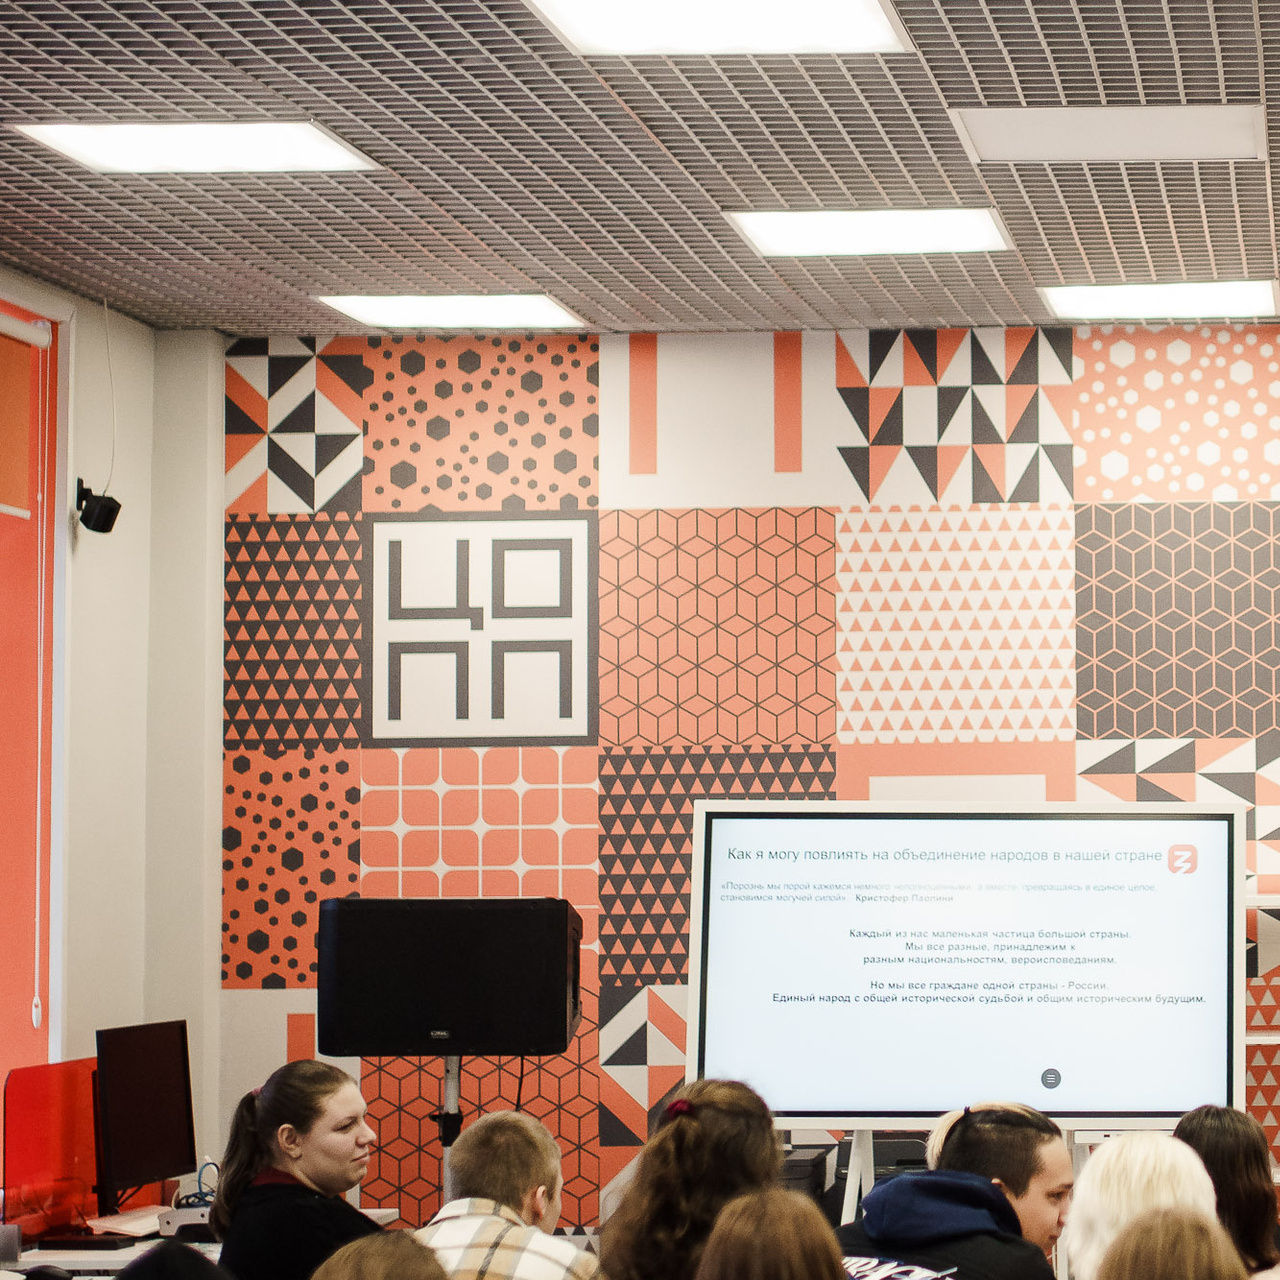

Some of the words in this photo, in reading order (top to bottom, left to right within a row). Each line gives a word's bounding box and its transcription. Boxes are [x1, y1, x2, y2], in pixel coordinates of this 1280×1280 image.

[727, 848, 752, 860] Как
[755, 850, 764, 860] я
[768, 850, 800, 863] могу
[803, 850, 868, 861] повлиять
[872, 851, 889, 861] на
[893, 848, 986, 862] объединение
[990, 851, 1049, 863] народов
[1053, 851, 1061, 861] в
[1065, 849, 1110, 861] нашей
[1114, 851, 1163, 863] стране
[783, 882, 810, 892] порой
[813, 883, 851, 891] кажемся
[1022, 883, 1083, 893] превращаясь
[1093, 884, 1125, 892] единое
[720, 894, 773, 902] становимся
[776, 893, 812, 903] могучей
[855, 893, 909, 903] Кристофер
[911, 894, 955, 902] Паолини
[849, 929, 892, 939] Каждый
[992, 931, 1035, 939] частица
[1038, 929, 1087, 939] большой
[1089, 931, 1132, 940] страны.
[905, 942, 923, 951] Мы
[926, 943, 944, 951] все
[947, 943, 990, 953] разные,
[993, 943, 1067, 952] принадлежим
[863, 956, 905, 966] разным
[908, 956, 1008, 965] национальностям,
[1011, 956, 1118, 966] вероисповеданиям.
[870, 981, 885, 990] Но
[888, 982, 905, 990] мы
[908, 982, 926, 990] все
[929, 982, 979, 991] граждане
[982, 981, 1015, 991] одной
[1018, 982, 1058, 991] страны
[1067, 981, 1110, 990] России.
[772, 993, 816, 1003] Единый
[819, 995, 851, 1005] народ
[854, 995, 860, 1003] с
[863, 994, 898, 1004] общей
[901, 994, 976, 1004] исторической
[979, 994, 1024, 1005] судьбой
[1036, 994, 1074, 1004] общим
[1076, 995, 1152, 1004] историческим
[1155, 994, 1207, 1005] будущим.
